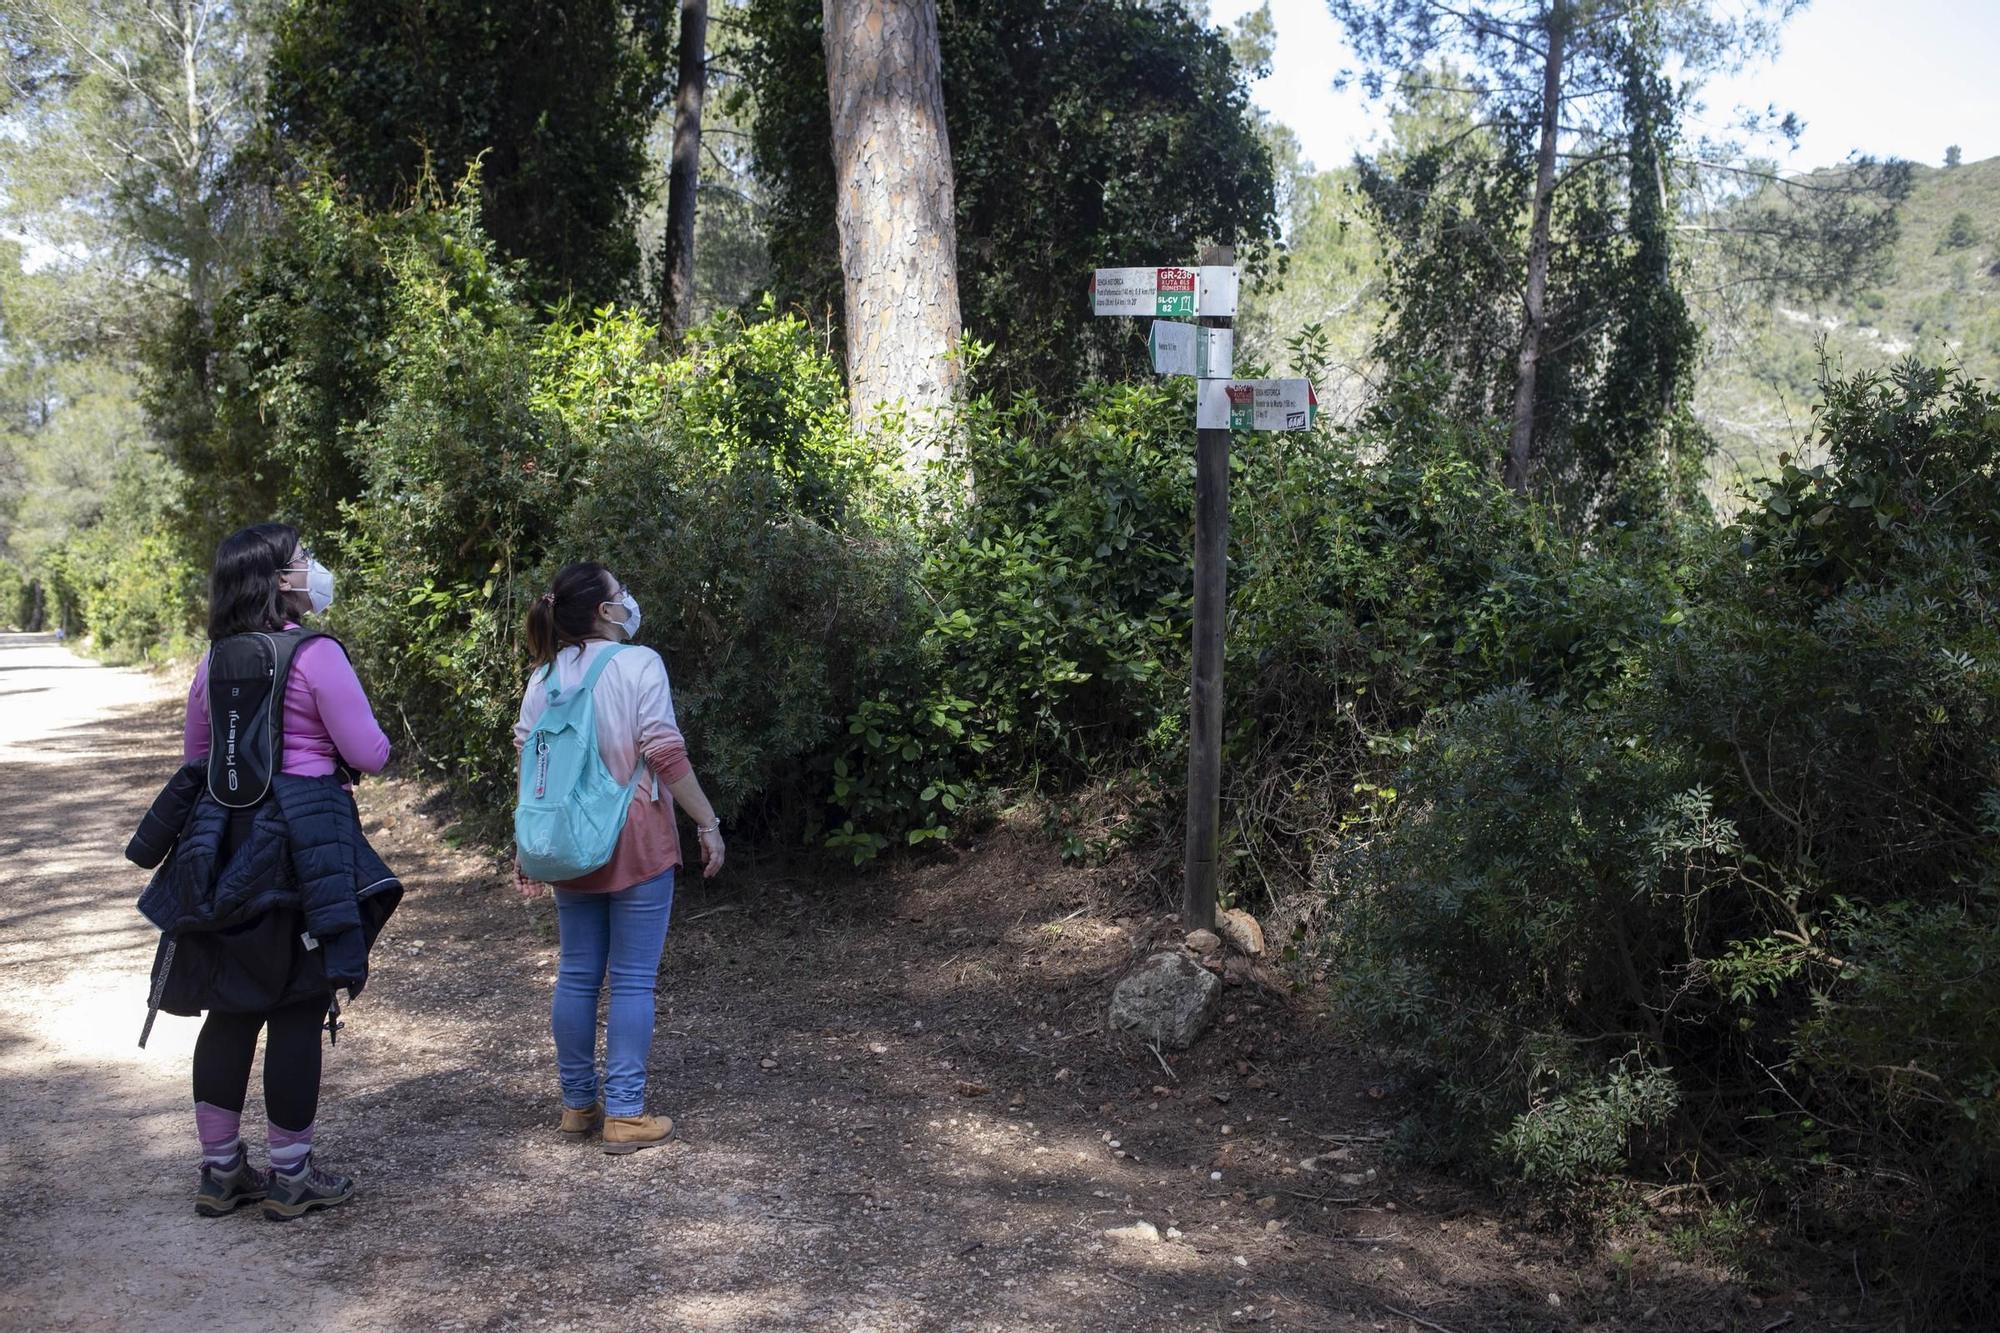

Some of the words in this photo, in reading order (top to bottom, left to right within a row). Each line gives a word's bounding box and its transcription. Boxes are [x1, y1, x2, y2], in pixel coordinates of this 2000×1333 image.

[1160, 270, 1192, 280] GR-236
[1157, 296, 1178, 304] SL-CV
[1162, 304, 1173, 313] 82
[1235, 417, 1243, 425] 82
[226, 710, 240, 766] Kalenji
